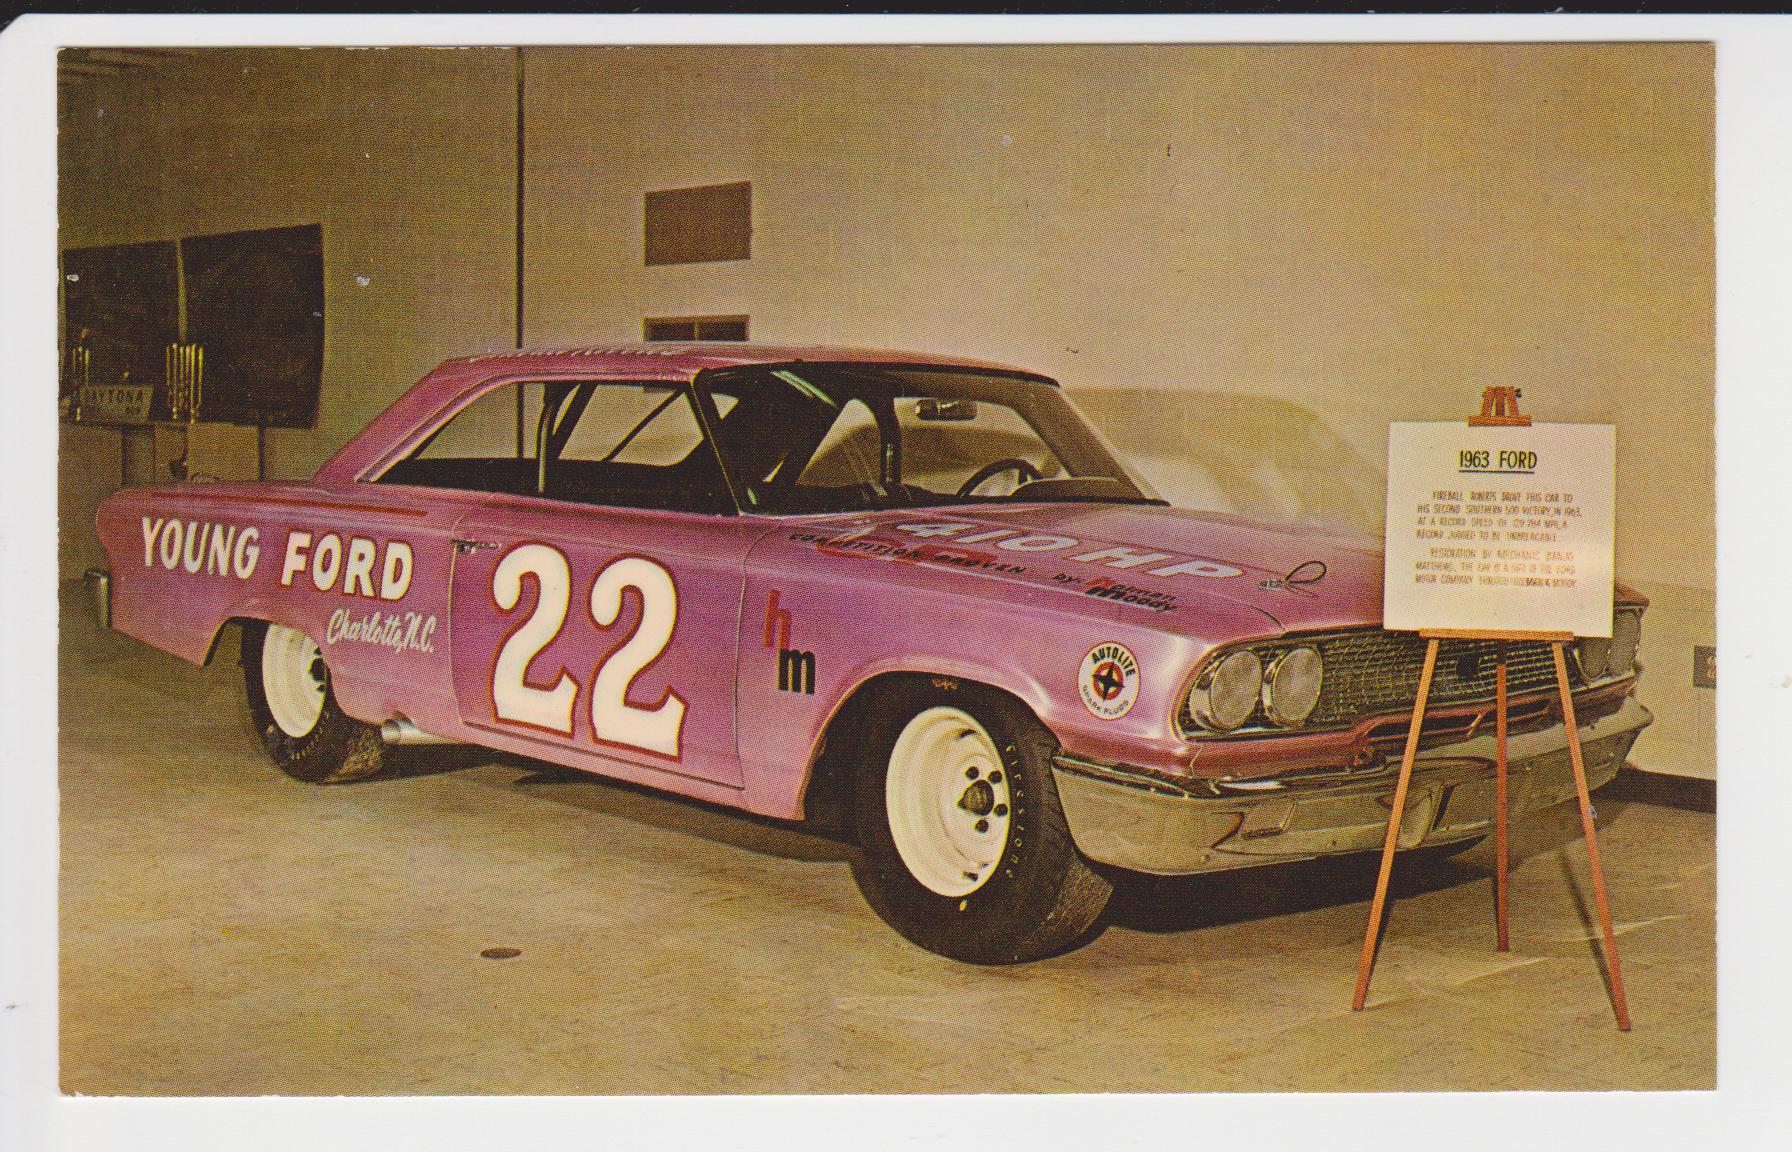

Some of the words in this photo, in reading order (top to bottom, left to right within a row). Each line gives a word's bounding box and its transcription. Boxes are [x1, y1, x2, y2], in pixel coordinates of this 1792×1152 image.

[1459, 450, 1490, 468] 1963
[1499, 451, 1538, 469] FORD
[141, 516, 261, 580] YOUNG
[279, 530, 415, 602] FORD
[893, 522, 1081, 552] 410
[1064, 546, 1245, 578] HP
[488, 540, 690, 764] 22
[1091, 646, 1136, 678] AUTOLITE
